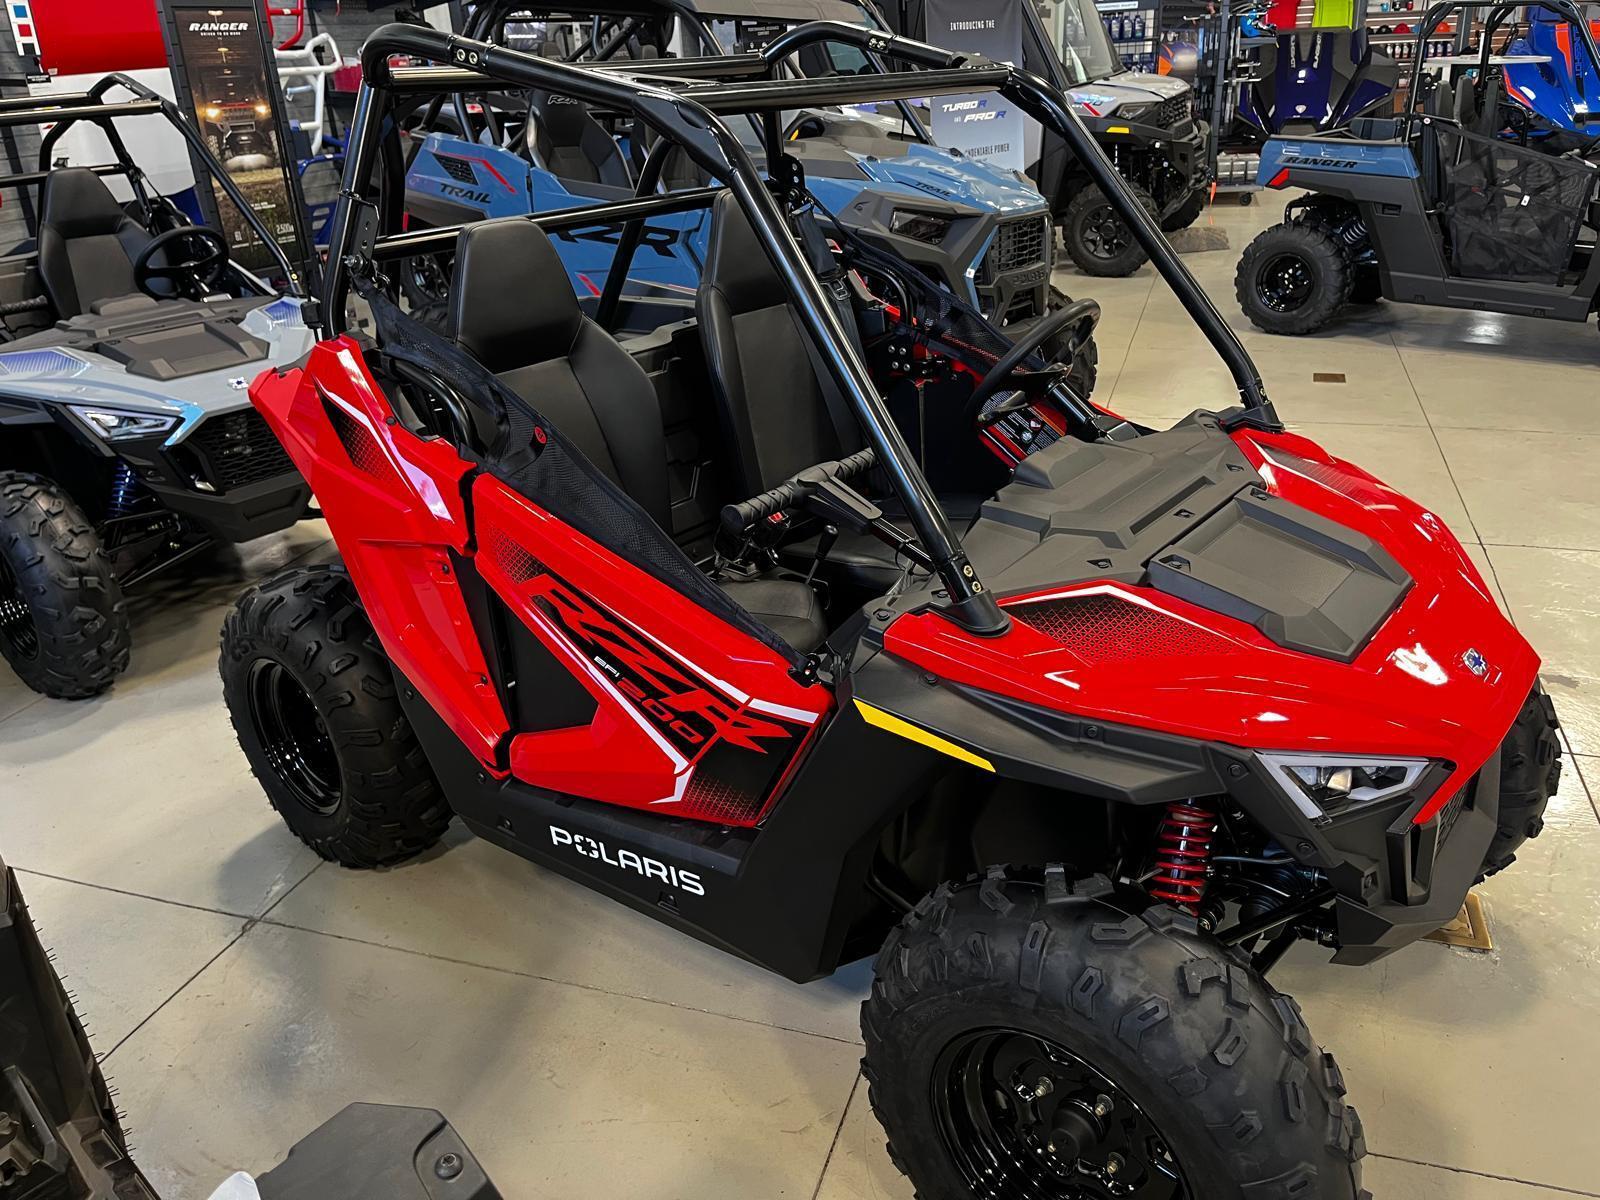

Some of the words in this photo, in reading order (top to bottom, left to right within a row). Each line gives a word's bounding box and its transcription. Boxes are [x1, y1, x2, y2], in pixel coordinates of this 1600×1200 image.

[189, 22, 249, 32] RANGER
[950, 21, 985, 31] INTRODUCING
[1285, 156, 1358, 169] RANGER
[439, 183, 492, 204] TRAIL
[915, 181, 951, 197] TRAIL
[528, 574, 793, 755] RZR
[593, 655, 621, 678] EFI
[616, 677, 705, 744] 200
[549, 825, 705, 896] POLARIS
